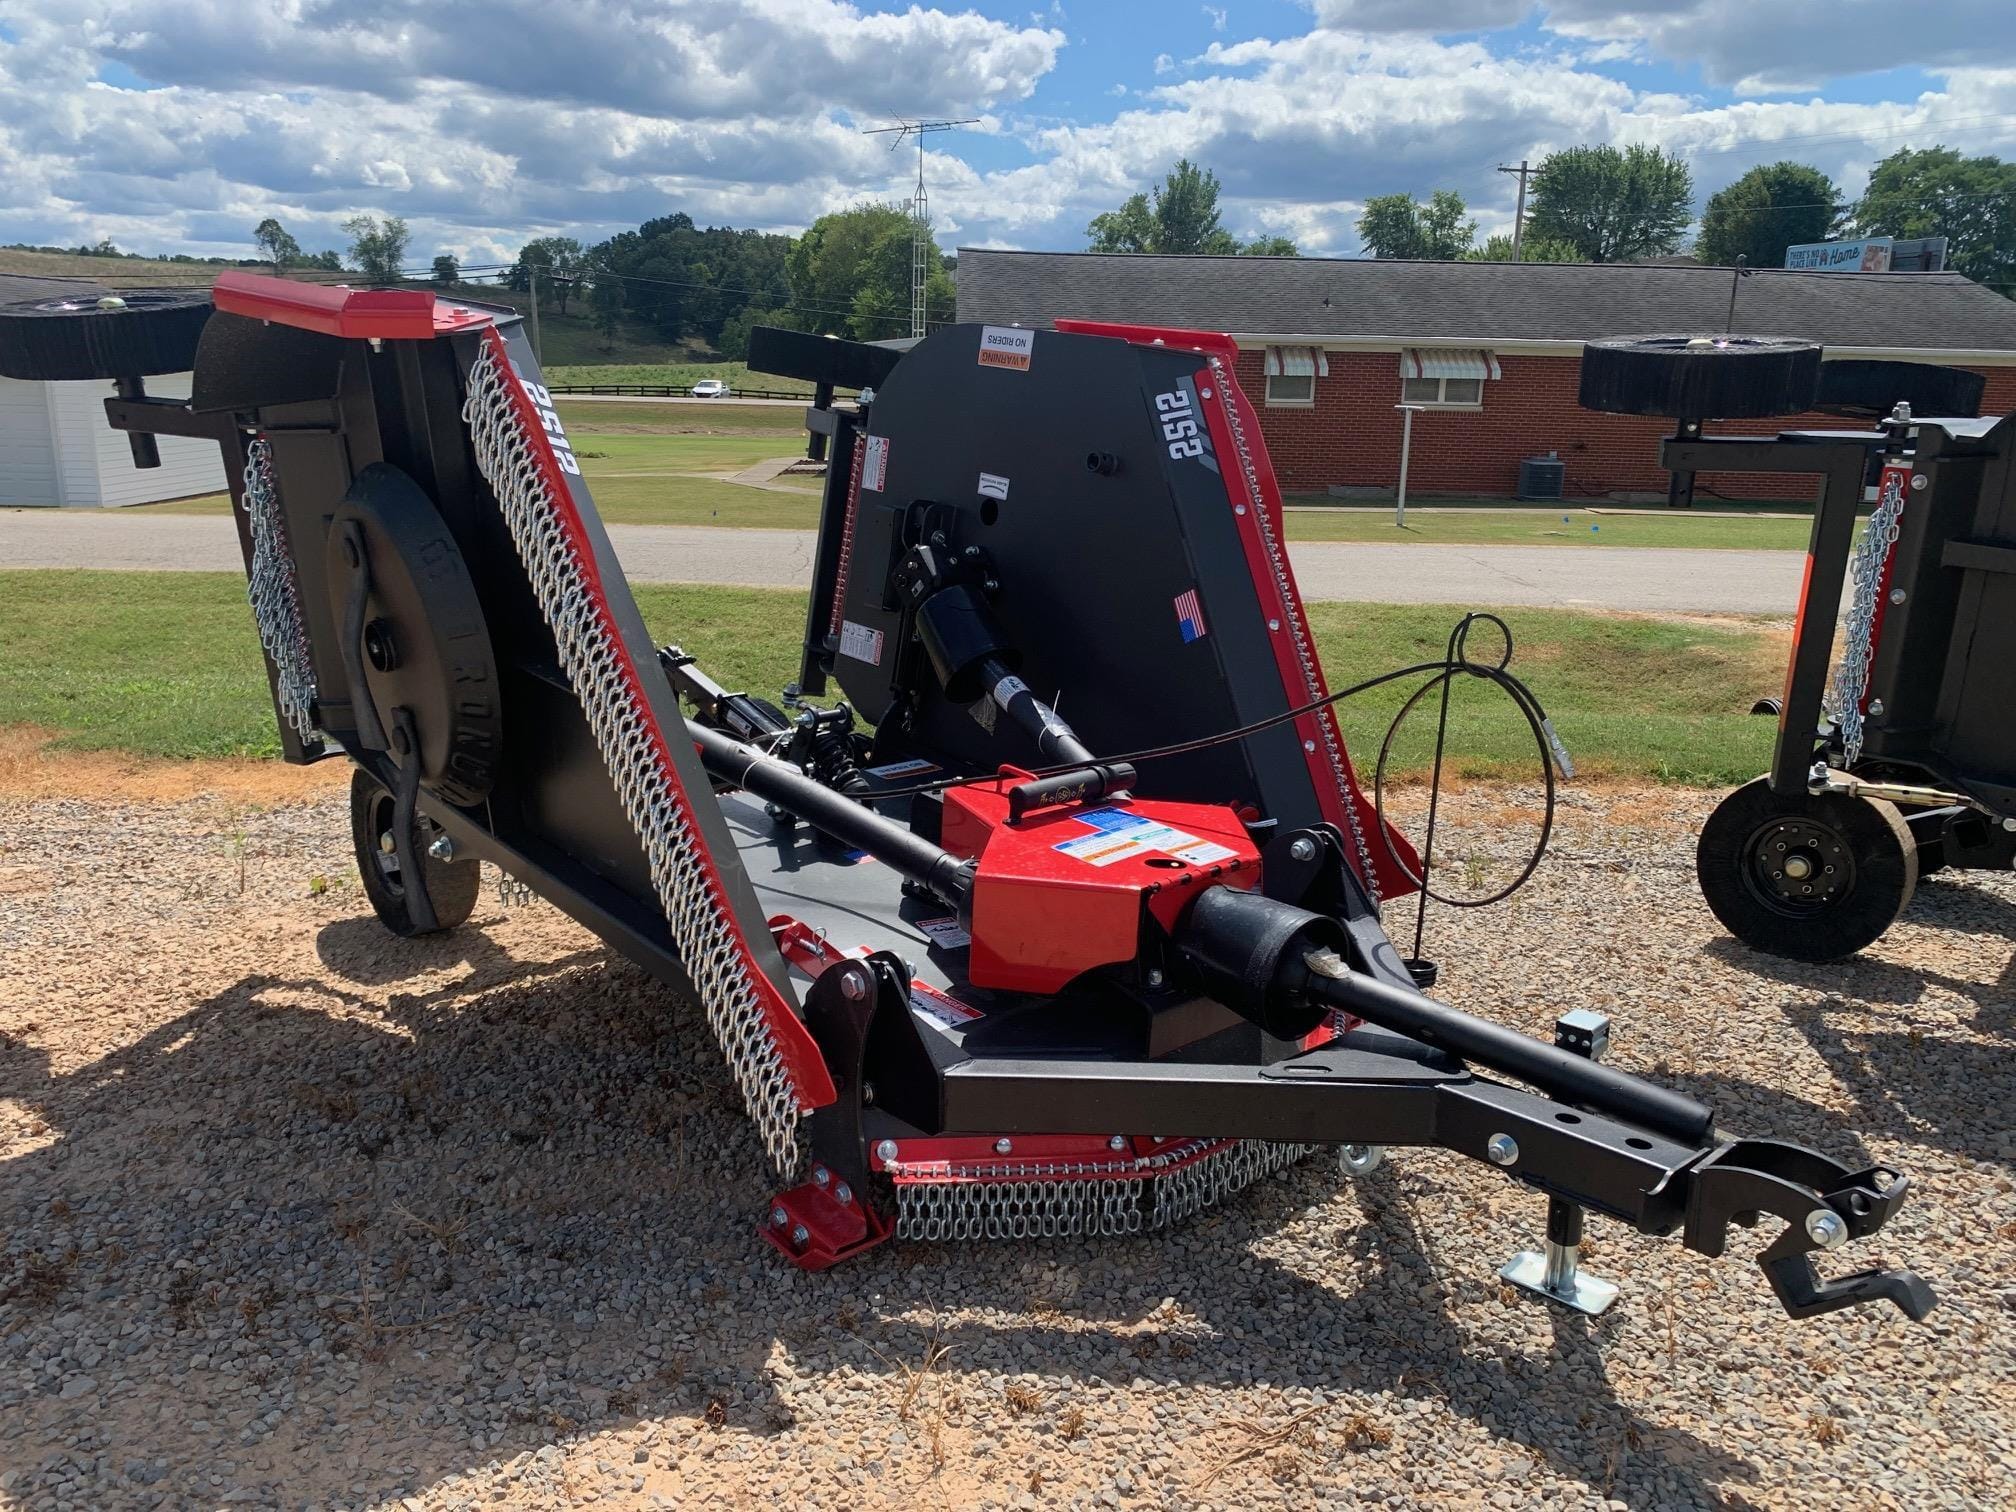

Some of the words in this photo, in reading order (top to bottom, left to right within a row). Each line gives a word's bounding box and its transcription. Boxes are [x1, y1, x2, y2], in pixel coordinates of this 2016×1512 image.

[1811, 249, 1819, 258] NO
[1829, 247, 1860, 266] Home
[987, 335, 1014, 346] RIDERS
[1015, 337, 1027, 348] NO
[982, 352, 1019, 366] WARNING
[518, 379, 580, 475] 2512
[1155, 389, 1204, 460] 2512
[933, 989, 967, 1011] DANGER
